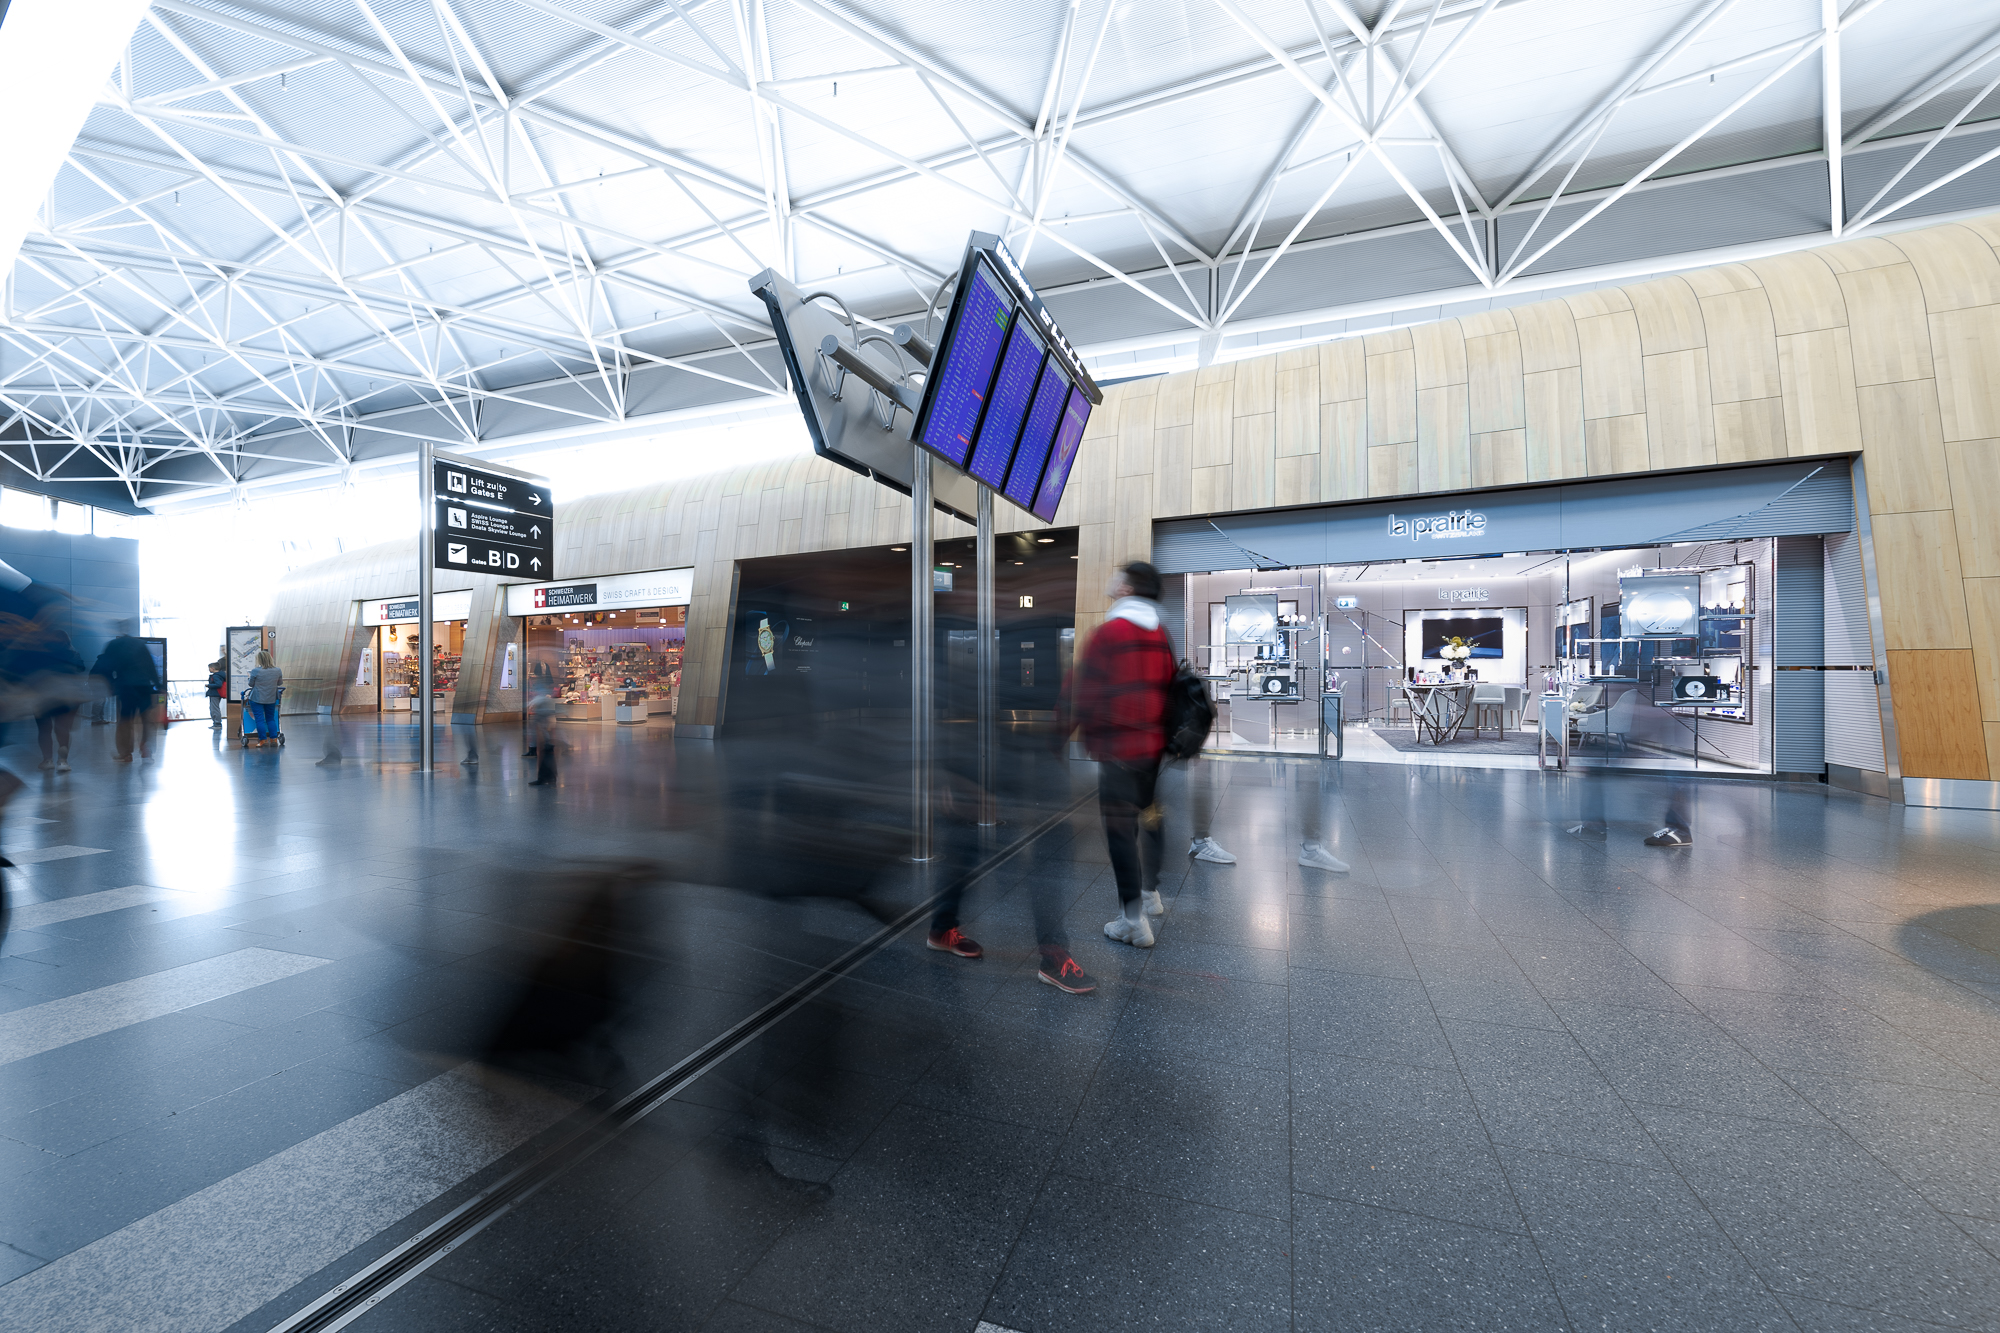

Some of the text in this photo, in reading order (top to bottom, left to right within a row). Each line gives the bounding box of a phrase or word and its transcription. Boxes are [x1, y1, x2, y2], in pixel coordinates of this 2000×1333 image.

[471, 478, 485, 488] Lift
[471, 487, 504, 500] Gates E
[471, 513, 508, 525] Aspire Lounge
[471, 518, 489, 526] SWISS
[490, 522, 509, 530] Lounge
[1388, 509, 1487, 541] la prairie
[488, 527, 508, 535] Skyview
[509, 530, 527, 538] Lounge
[1431, 530, 1485, 540] SWITZERLAND
[471, 558, 487, 566] Gates
[548, 587, 573, 596] SCHWEIZER
[602, 586, 679, 600] SWISS CRAFT & DESIGN
[1438, 587, 1490, 603] la prairie
[548, 593, 594, 606] HEIMATWERK
[389, 608, 418, 618] HEIMATWERK
[793, 635, 814, 648] Chopard
